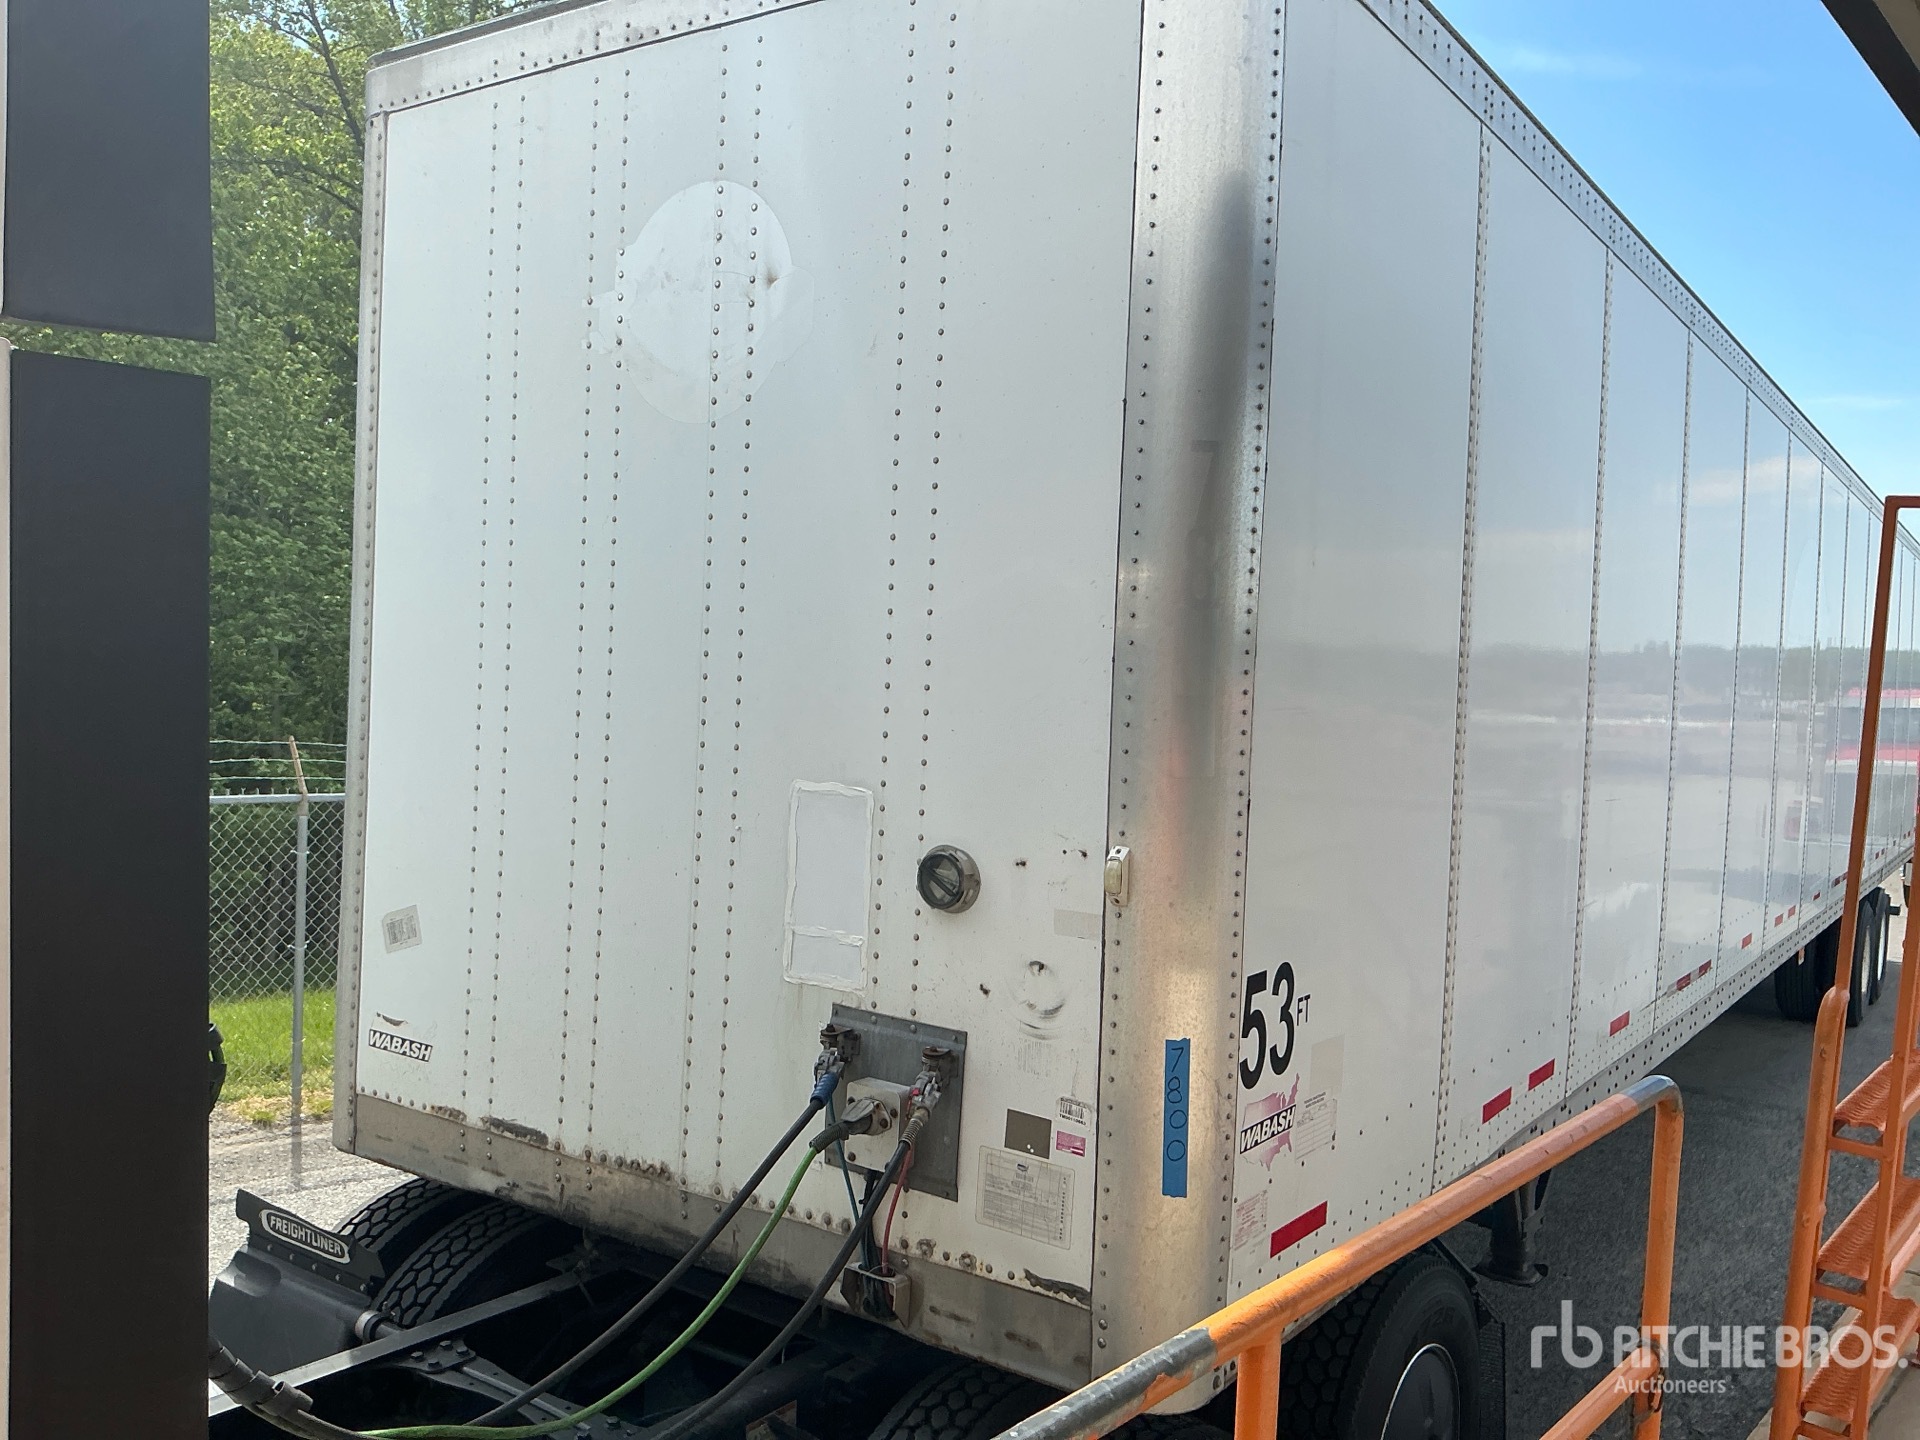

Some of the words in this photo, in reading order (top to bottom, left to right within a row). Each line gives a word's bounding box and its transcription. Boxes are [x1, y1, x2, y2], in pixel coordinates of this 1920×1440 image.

[369, 1031, 432, 1061] WABASH
[1239, 961, 1295, 1090] 53
[1296, 994, 1311, 1026] FT
[1166, 1047, 1188, 1162] 7800
[1240, 1106, 1296, 1152] WABASH
[269, 1215, 342, 1256] FREIGHTLINER
